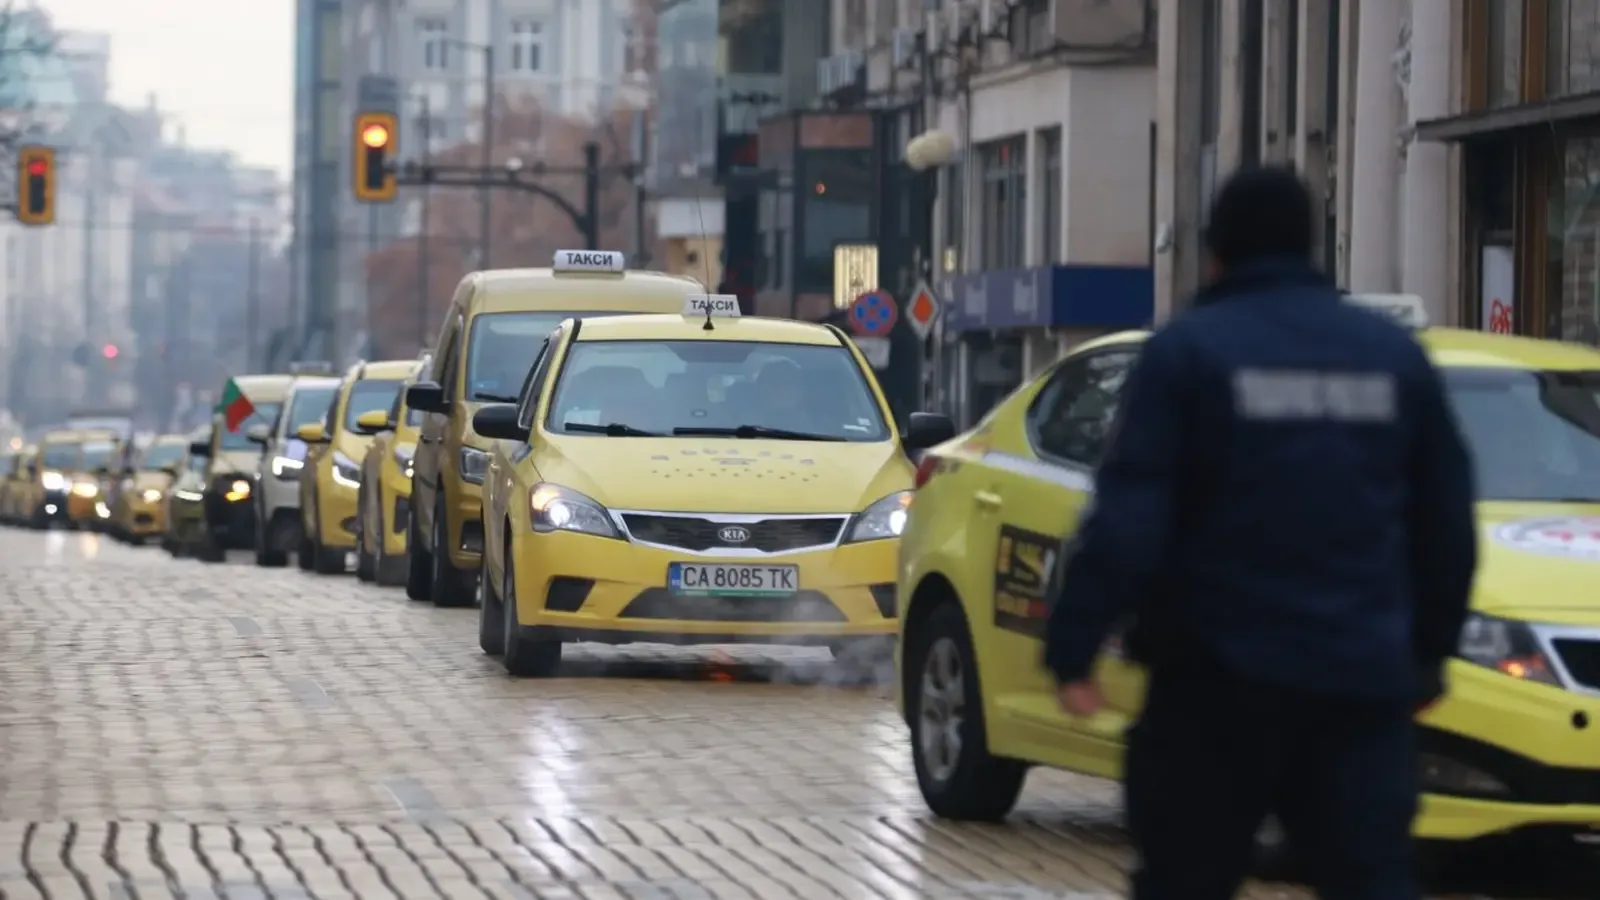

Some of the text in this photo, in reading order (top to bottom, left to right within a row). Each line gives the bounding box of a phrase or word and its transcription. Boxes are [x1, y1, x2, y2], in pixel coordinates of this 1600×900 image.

[566, 252, 613, 266] ТАКСИ
[691, 300, 734, 311] ТАКСИ
[723, 529, 746, 540] KIA
[683, 567, 793, 589] CA 8085 TK
